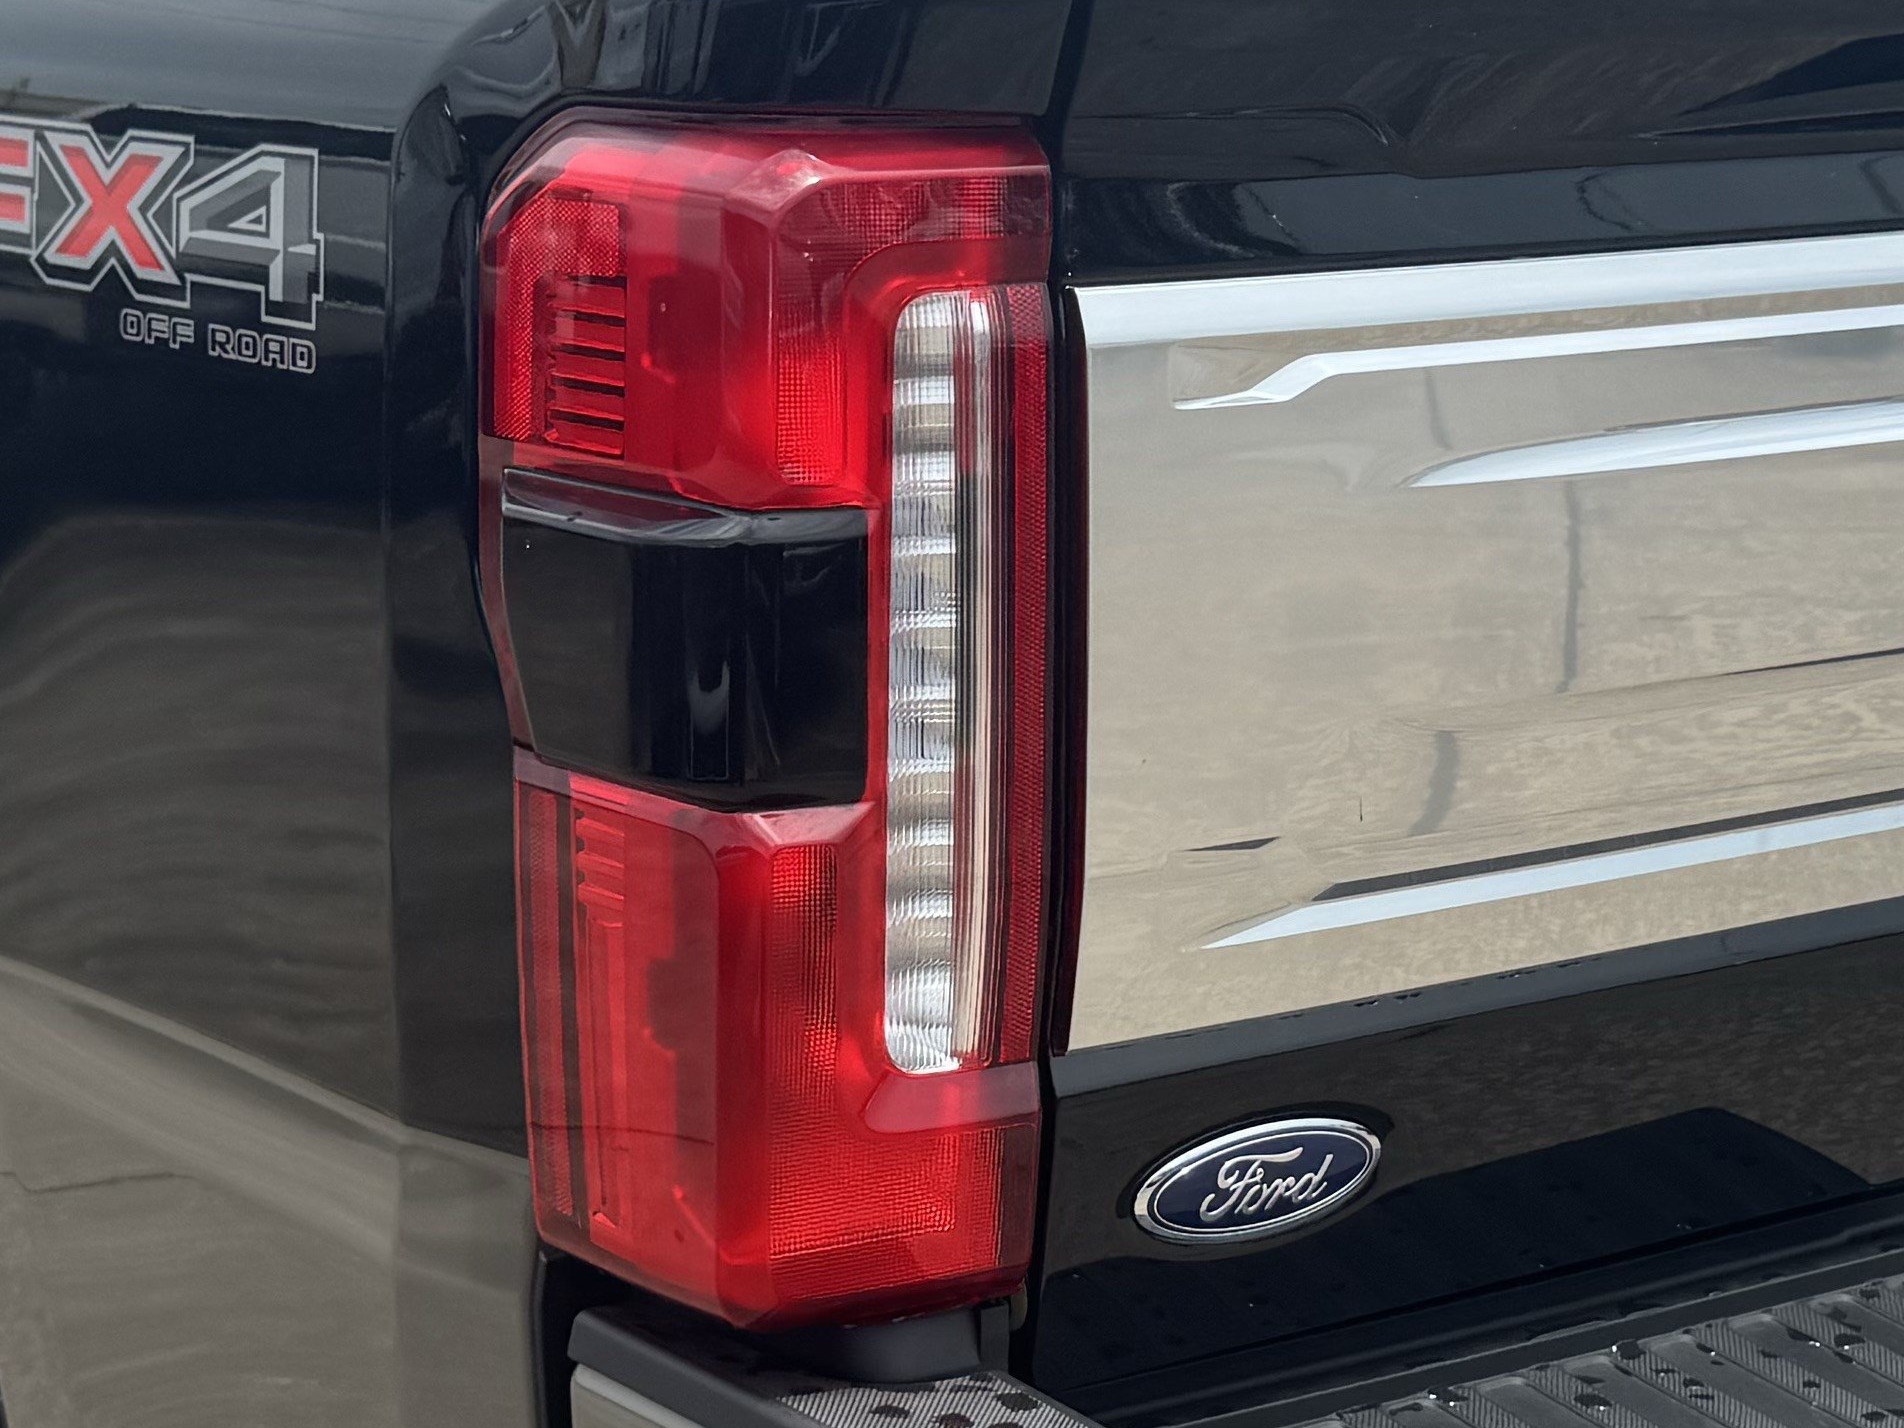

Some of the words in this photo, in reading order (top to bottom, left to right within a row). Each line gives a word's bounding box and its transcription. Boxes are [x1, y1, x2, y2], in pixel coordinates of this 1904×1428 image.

[120, 308, 195, 349] OFF
[207, 324, 316, 373] ROAD
[1199, 1146, 1334, 1222] Ford
